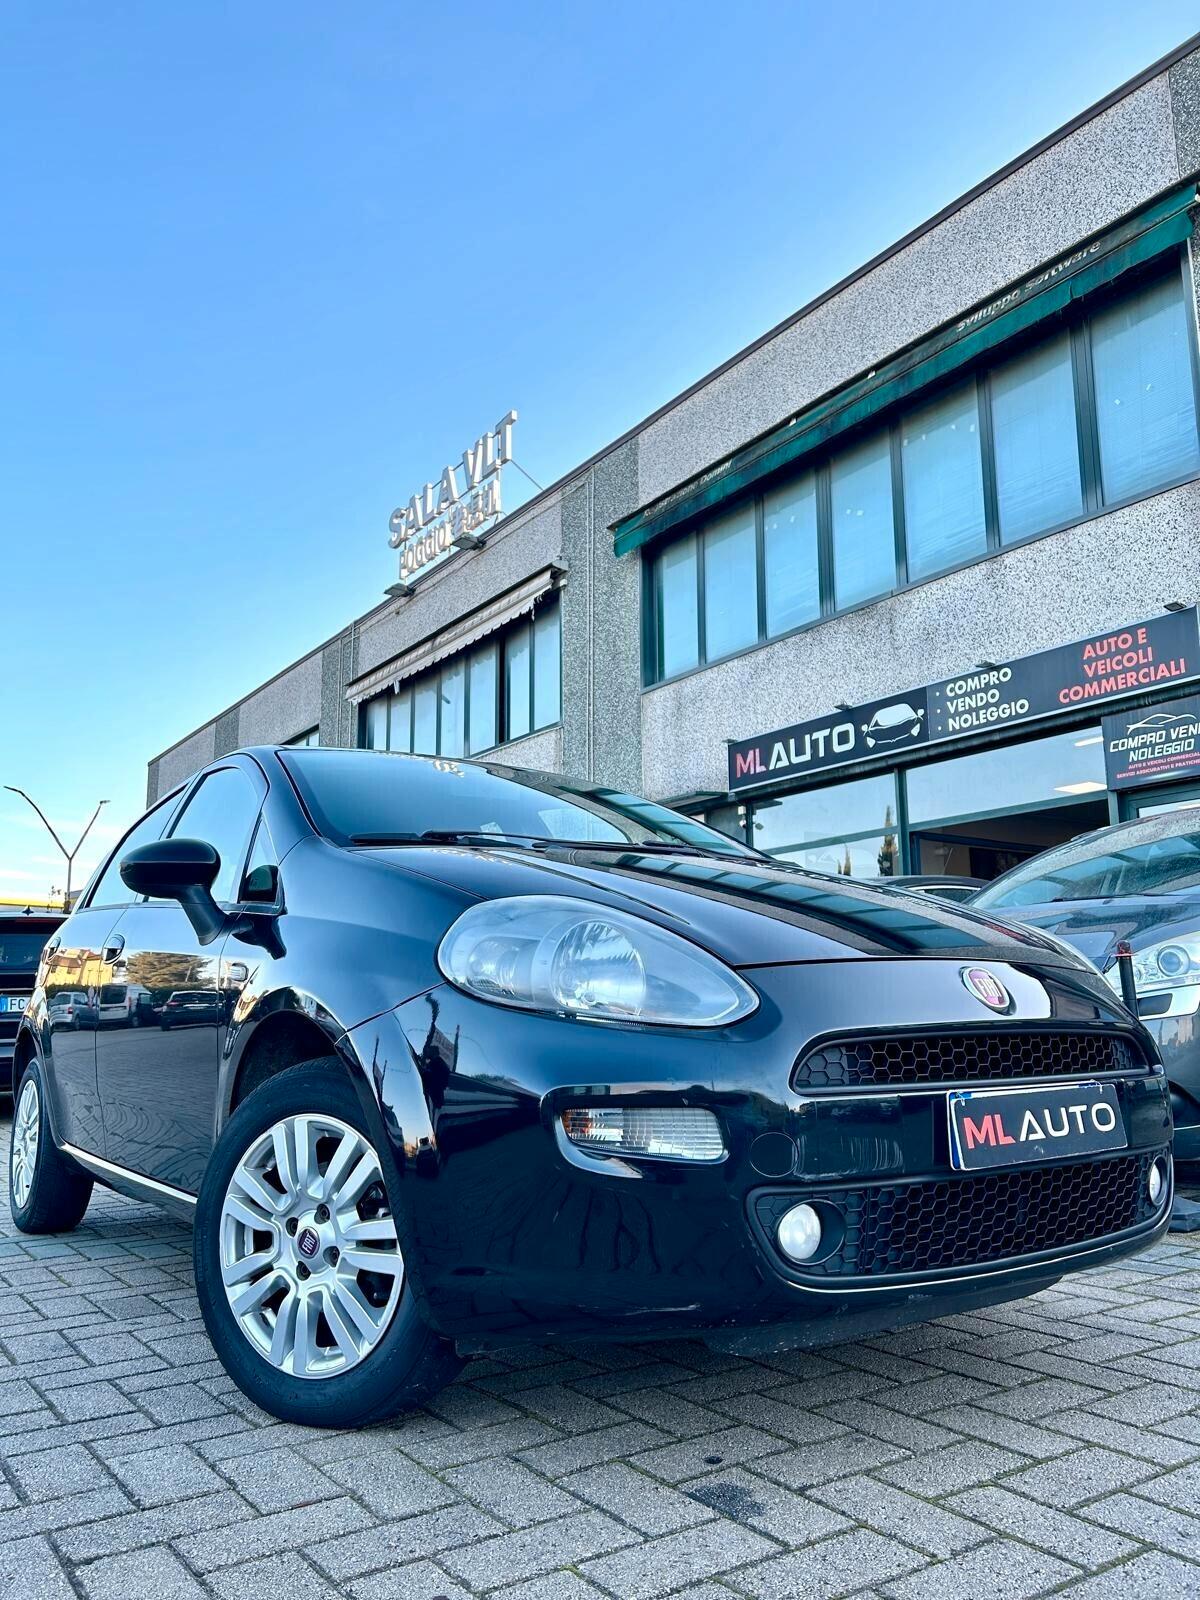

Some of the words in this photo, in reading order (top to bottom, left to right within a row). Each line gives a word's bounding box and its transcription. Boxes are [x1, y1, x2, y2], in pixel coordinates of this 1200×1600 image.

[388, 465, 460, 549] SALA
[463, 410, 517, 490] VLT
[1083, 633, 1133, 660] AUTO
[1137, 628, 1147, 644] E
[1084, 647, 1153, 678] VEICOLI
[946, 667, 1012, 697] COMPRO
[1059, 658, 1186, 704] COMMERCIALI
[947, 688, 1000, 715] VENDO
[948, 698, 1029, 731] NOLEGGIO
[1110, 730, 1166, 753] COMPRO
[1170, 722, 1200, 740] VEN
[1129, 738, 1195, 762] NOLEGGIO
[973, 978, 1002, 998] FIAT
[302, 1231, 316, 1254] FIAT
